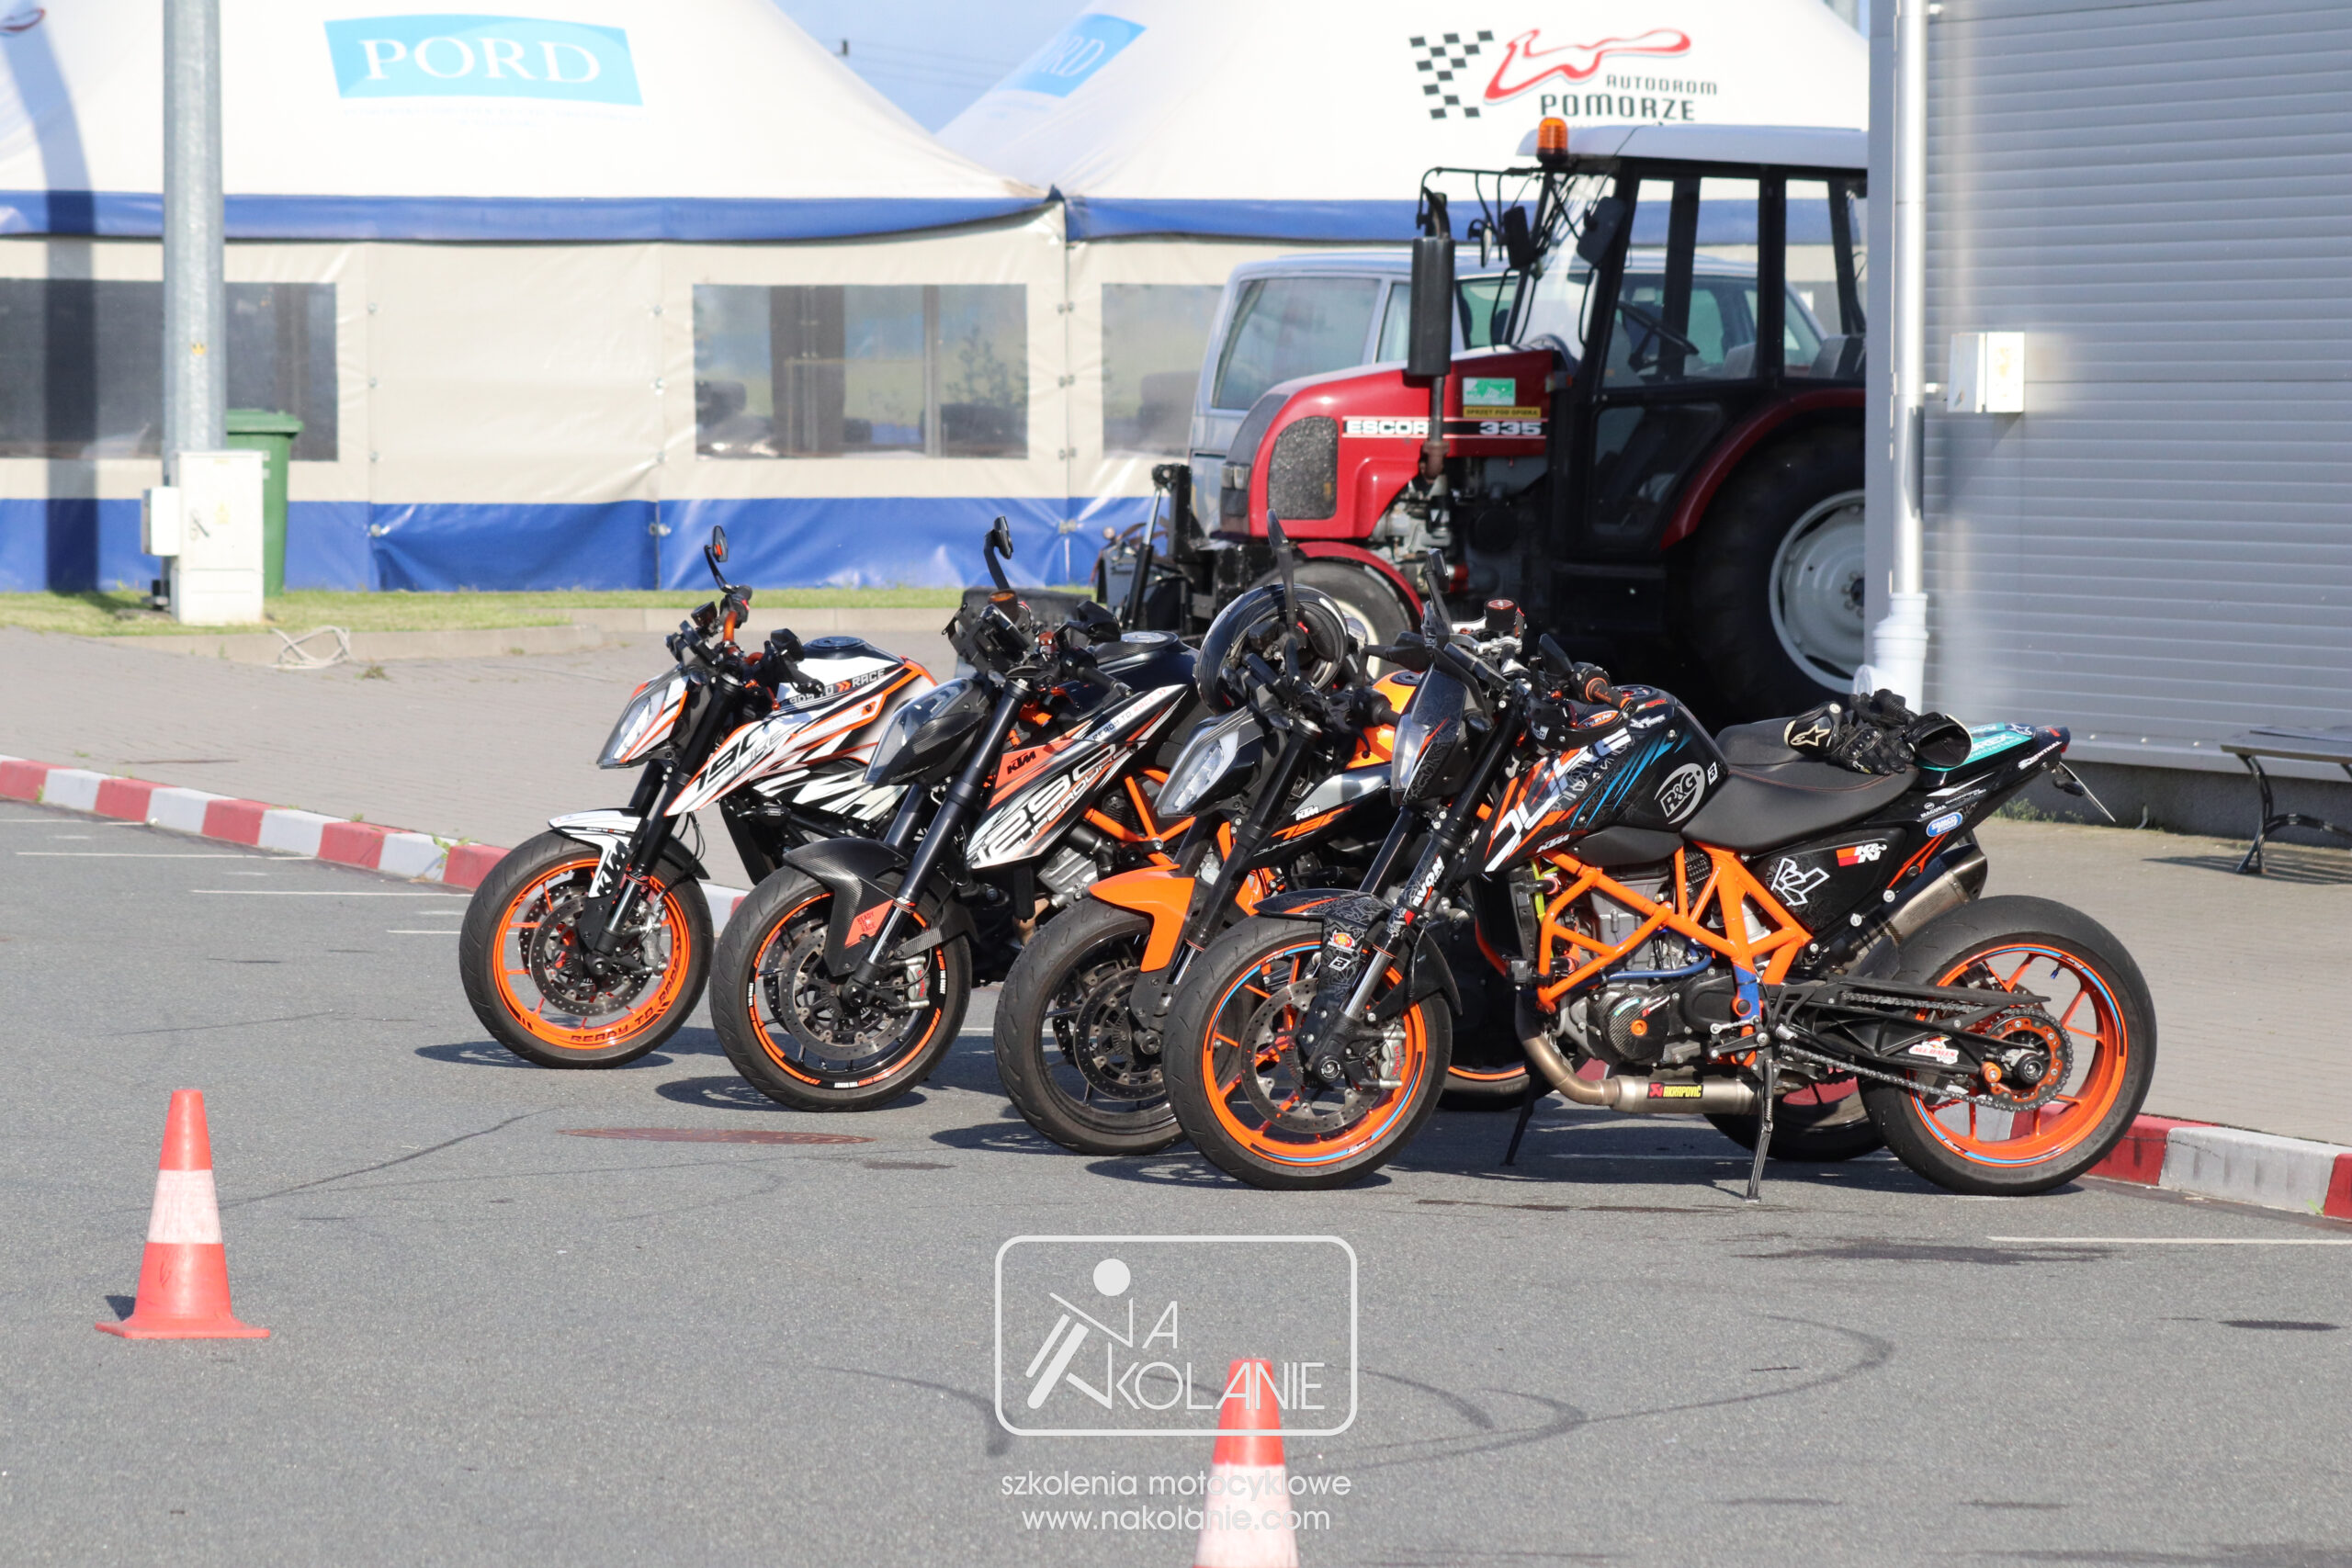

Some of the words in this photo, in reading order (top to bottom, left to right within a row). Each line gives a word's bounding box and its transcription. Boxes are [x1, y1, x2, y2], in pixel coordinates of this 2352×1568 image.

[359, 35, 603, 85] PORD
[1606, 74, 1718, 95] AUTODROM
[1540, 94, 1696, 121] POMORZE
[1345, 420, 1430, 435] ESCOR
[1479, 421, 1542, 435] 335
[852, 669, 886, 688] RACE
[1007, 750, 1036, 774] KTM
[976, 742, 1117, 864] 1290
[1661, 771, 1699, 817] R&G
[1295, 806, 1319, 821] KTM
[1920, 804, 1947, 818] MAGURA
[1536, 833, 1571, 853] KTM
[1854, 842, 1887, 863] K&N
[1412, 854, 1445, 908] AVON
[571, 1024, 628, 1043] READY
[635, 1007, 654, 1025] TO
[658, 958, 680, 1003] RACE
[1392, 1045, 1402, 1077] brembo
